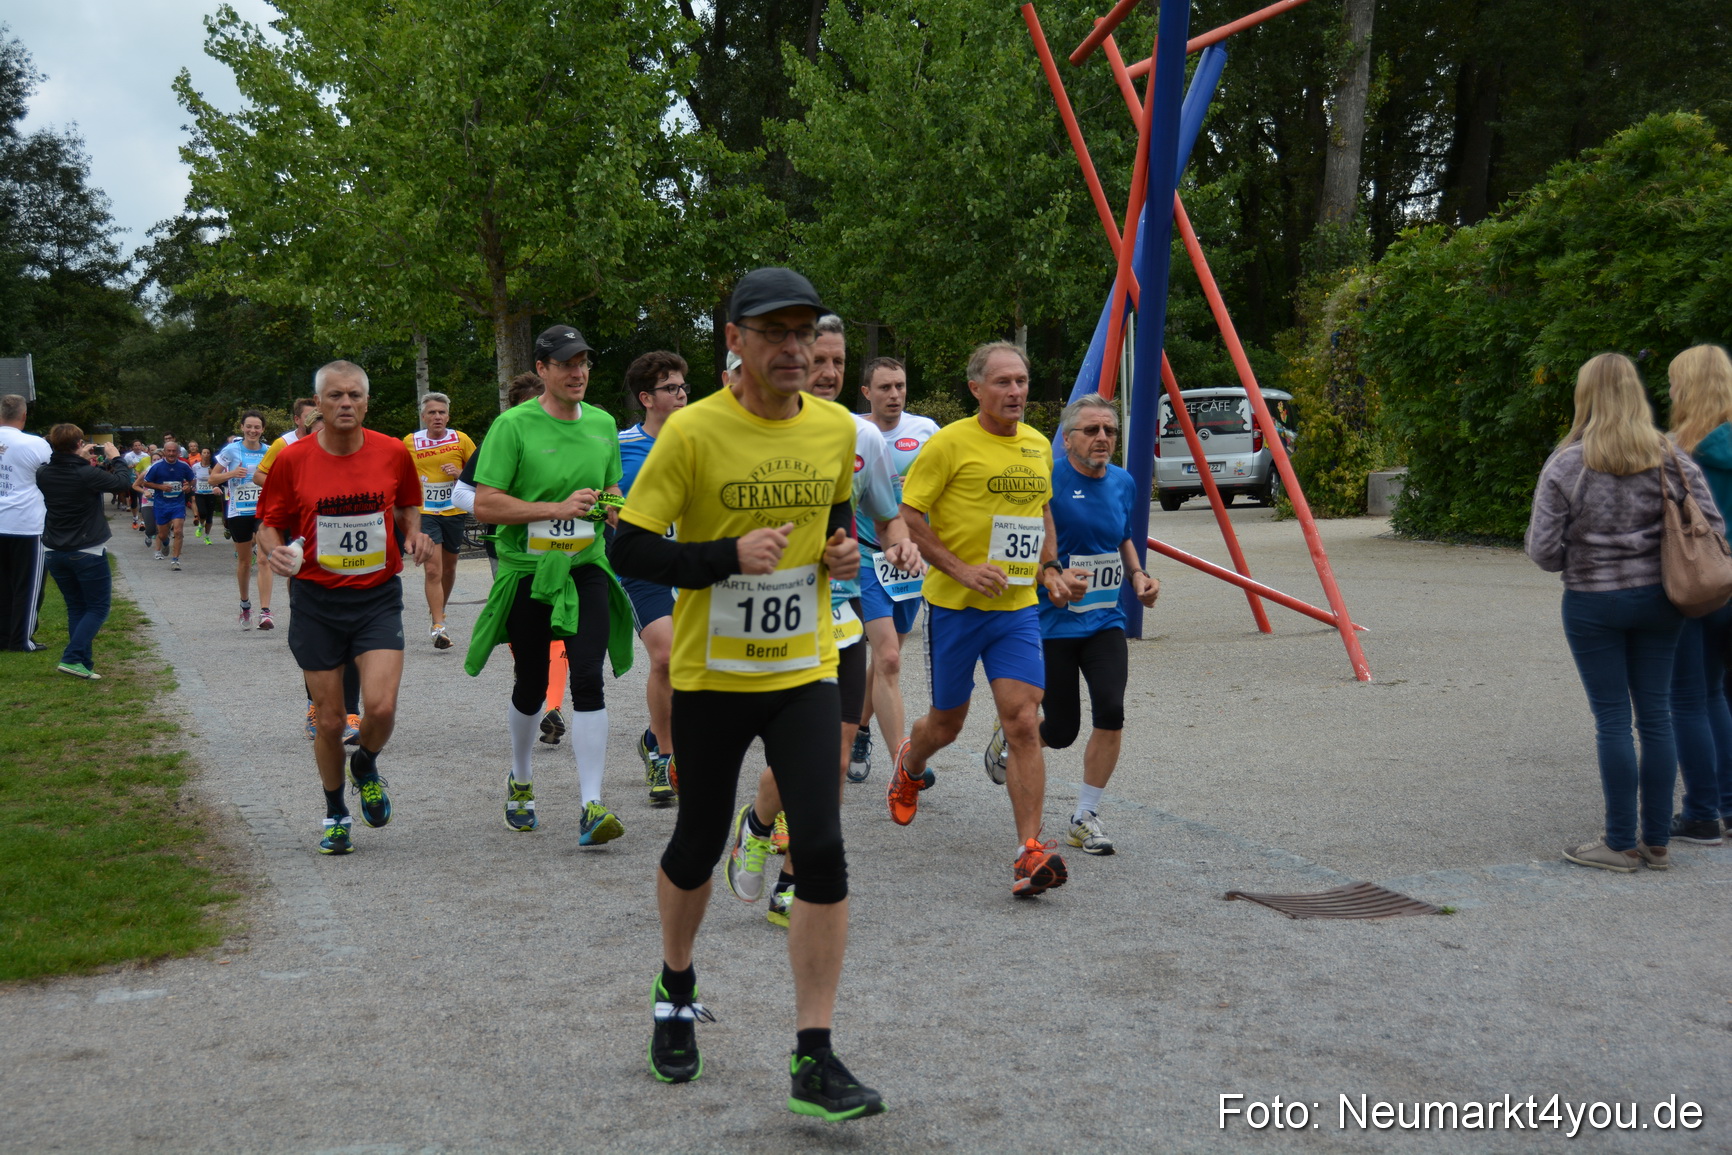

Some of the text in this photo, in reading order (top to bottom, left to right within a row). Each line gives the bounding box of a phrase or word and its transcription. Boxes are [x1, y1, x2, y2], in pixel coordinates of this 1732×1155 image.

[417, 450, 437, 459] MAX
[751, 460, 817, 482] PIZZERIA
[998, 479, 1042, 490] FRANCESCO
[426, 488, 452, 500] 2799
[737, 483, 829, 507] FRANCESCO
[343, 521, 376, 529] Neumarkt
[549, 519, 575, 537] 39
[994, 522, 1017, 530] PARTL
[340, 531, 368, 552] 48
[550, 541, 574, 550] Peter
[1005, 533, 1039, 559] 354
[342, 558, 365, 567] Erich
[1092, 564, 1121, 588] 108
[715, 578, 804, 592] PARTL Neumarkt
[737, 594, 801, 633] 186
[832, 627, 845, 639] ald
[746, 643, 788, 657] Bernd
